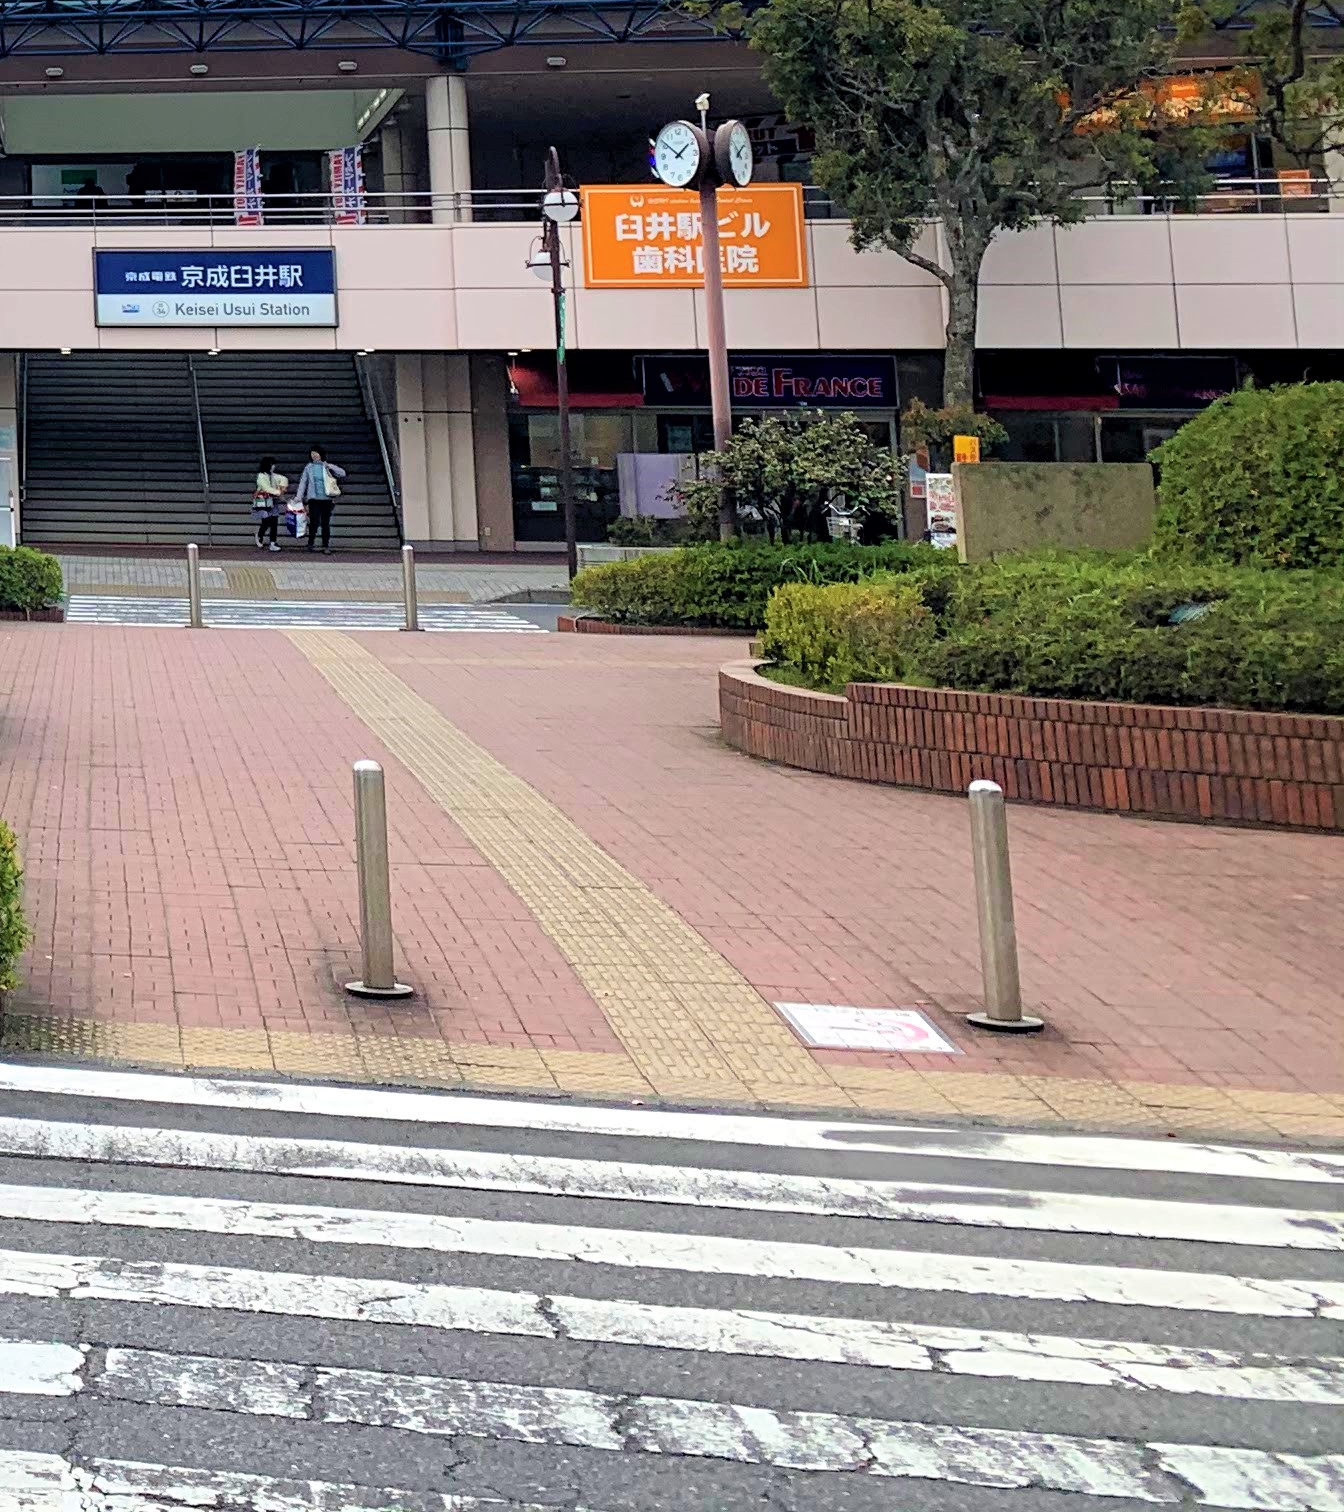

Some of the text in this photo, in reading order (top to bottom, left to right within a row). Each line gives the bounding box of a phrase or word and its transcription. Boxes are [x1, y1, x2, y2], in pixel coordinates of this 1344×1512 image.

[180, 264, 304, 289] 京成臼井駅
[175, 302, 220, 317] Keisei
[223, 302, 256, 317] Usui
[260, 302, 310, 317] Station
[733, 377, 769, 397] DE
[772, 368, 883, 397] FRANCE
